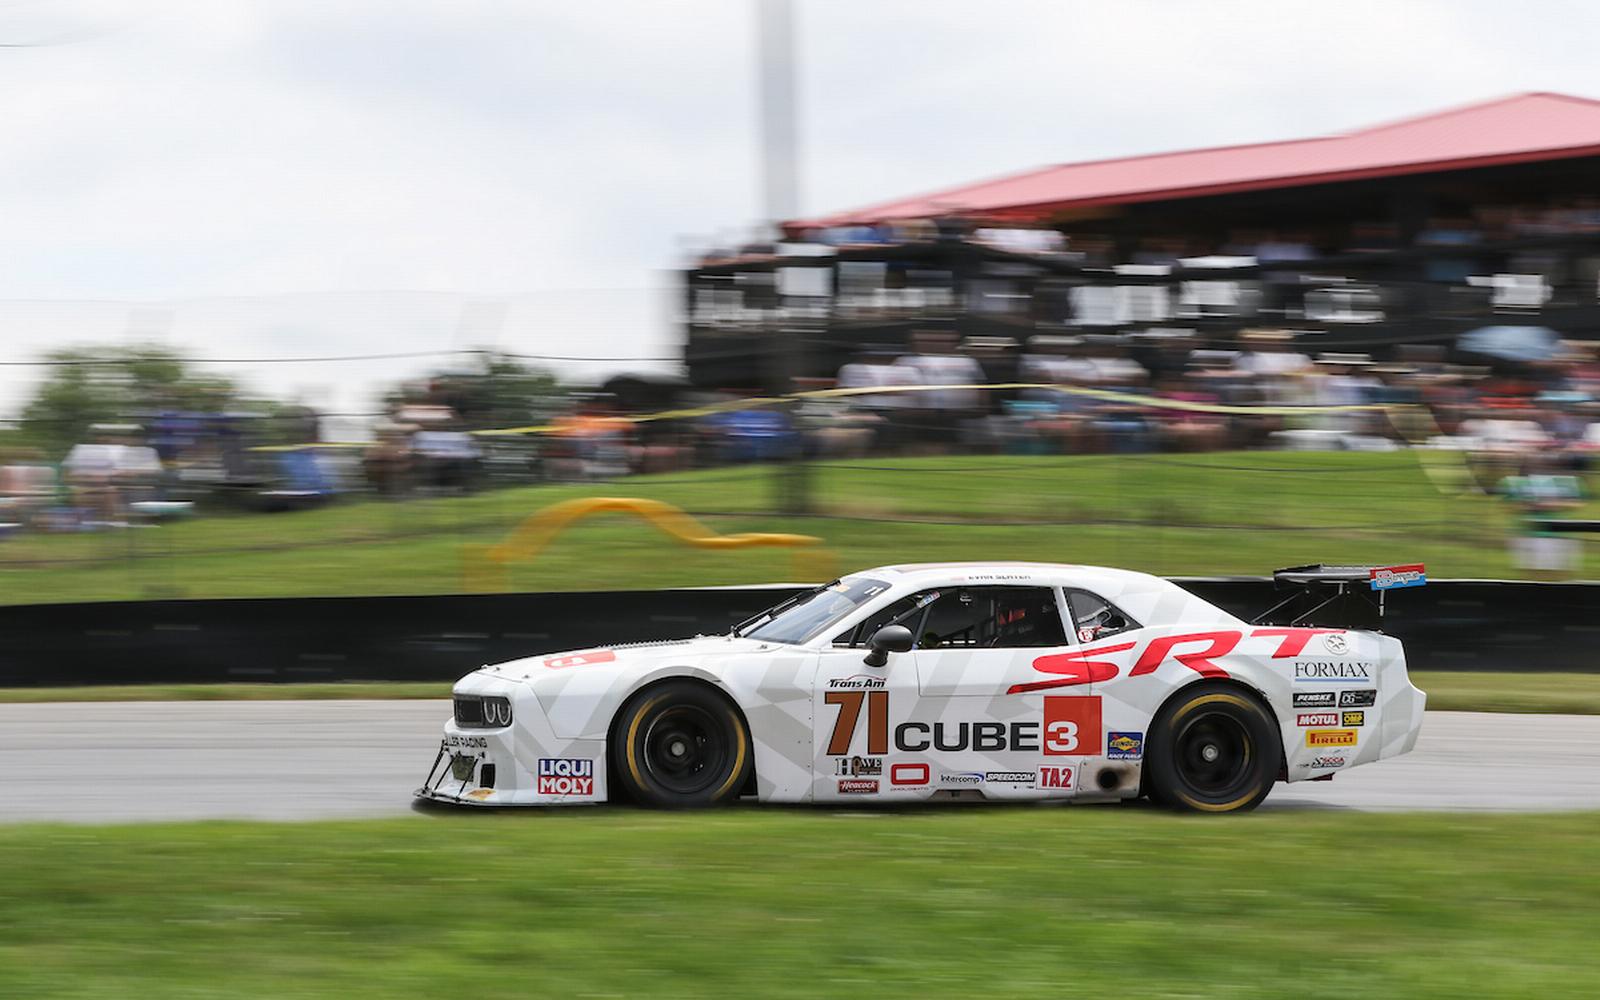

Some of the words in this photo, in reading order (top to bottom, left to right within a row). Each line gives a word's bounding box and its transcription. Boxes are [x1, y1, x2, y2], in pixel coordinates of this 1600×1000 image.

[1007, 629, 1347, 694] SRT
[1295, 662, 1369, 677] FORMAX
[829, 679, 862, 688] Trans
[863, 678, 885, 688] Am
[1297, 693, 1333, 701] PENSKE
[825, 691, 889, 755] 71
[1299, 714, 1337, 725] MOTUL
[1344, 714, 1363, 724] OMP
[1310, 732, 1354, 744] PIRELLI
[540, 760, 591, 776] LIQUI
[940, 773, 980, 784] Intercomp
[987, 772, 1035, 782] SPEEDCOM
[1040, 767, 1073, 788] TA2
[540, 777, 592, 794] MOLY
